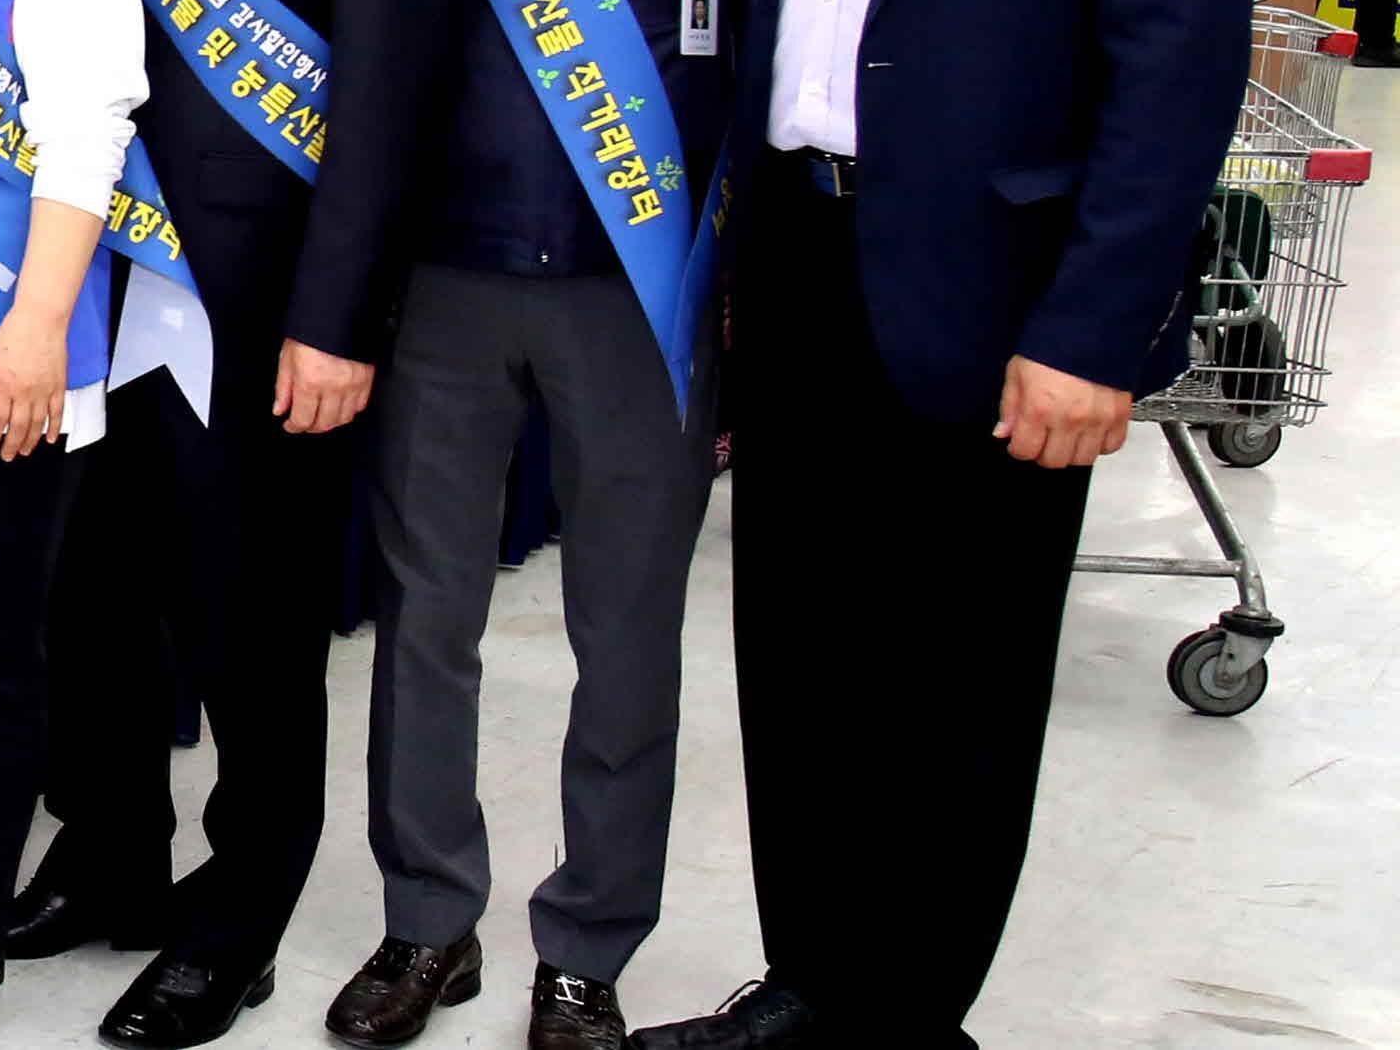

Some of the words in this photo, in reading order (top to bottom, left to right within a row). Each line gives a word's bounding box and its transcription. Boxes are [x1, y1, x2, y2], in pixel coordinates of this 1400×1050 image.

[197, 26, 238, 70] 및
[230, 58, 330, 166] 농특산물
[228, 1, 328, 94] 감사할인행사
[566, 61, 664, 227] 직거래장터
